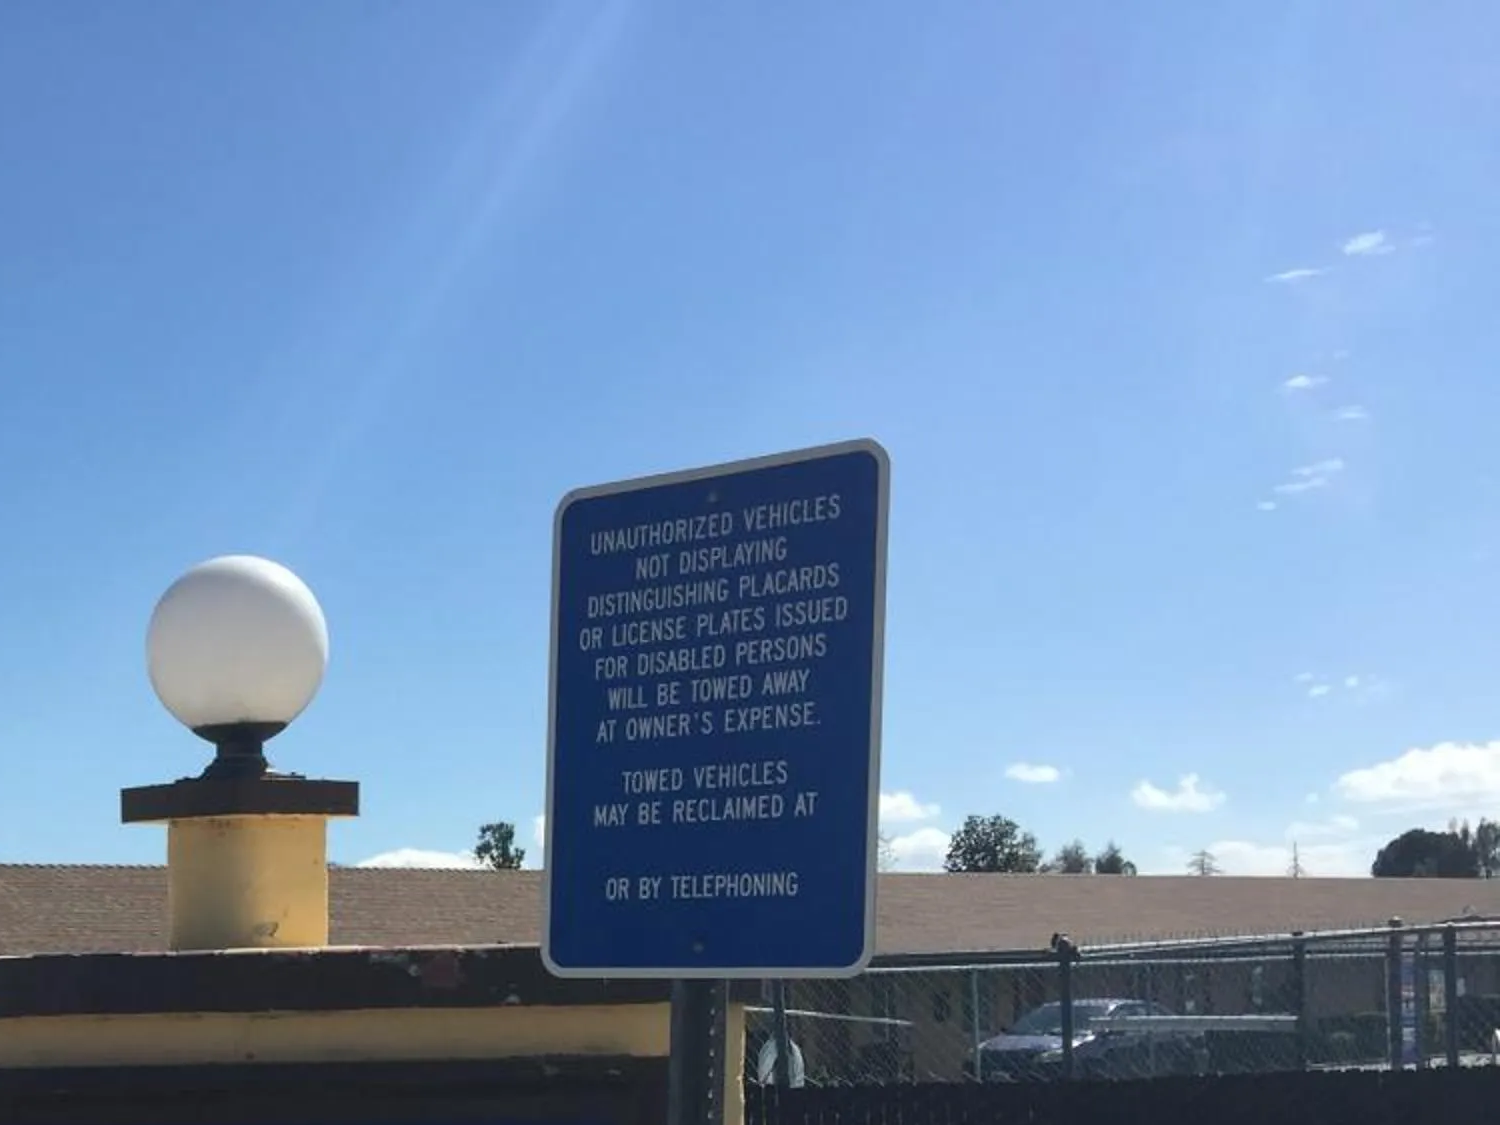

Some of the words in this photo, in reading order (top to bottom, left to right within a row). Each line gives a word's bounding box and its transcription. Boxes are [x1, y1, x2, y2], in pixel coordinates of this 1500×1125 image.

[591, 512, 733, 555] UNAUTHORIZED
[744, 495, 841, 531] VEHICLES
[636, 554, 671, 580] NOT
[680, 537, 787, 575] DISPLAYING
[588, 579, 729, 618] DISTINGUISHING
[740, 563, 839, 599] PLACARDS
[580, 627, 602, 651] OR
[612, 616, 686, 647] LICENSE
[697, 607, 765, 637] PLATES
[776, 597, 847, 627] ISSUED
[595, 655, 628, 680] FOR
[638, 645, 725, 676] DISABLED
[736, 633, 827, 666] PERSONS
[608, 688, 648, 710] WILL
[657, 682, 681, 706] BE
[691, 674, 751, 702] TOWED
[762, 668, 810, 695] AWAY
[596, 720, 616, 743] AT
[626, 711, 713, 741] OWNER'S
[724, 702, 821, 733] EXPENSE.
[622, 768, 683, 794] TOWED
[694, 760, 788, 789] VEHICLES
[594, 803, 628, 827] MAY
[638, 801, 661, 824] BE
[673, 794, 783, 823] RECLAIMED
[794, 791, 818, 816] AT
[606, 877, 629, 900] OR
[639, 877, 662, 899] BY
[671, 872, 798, 898] TELEPHONING
